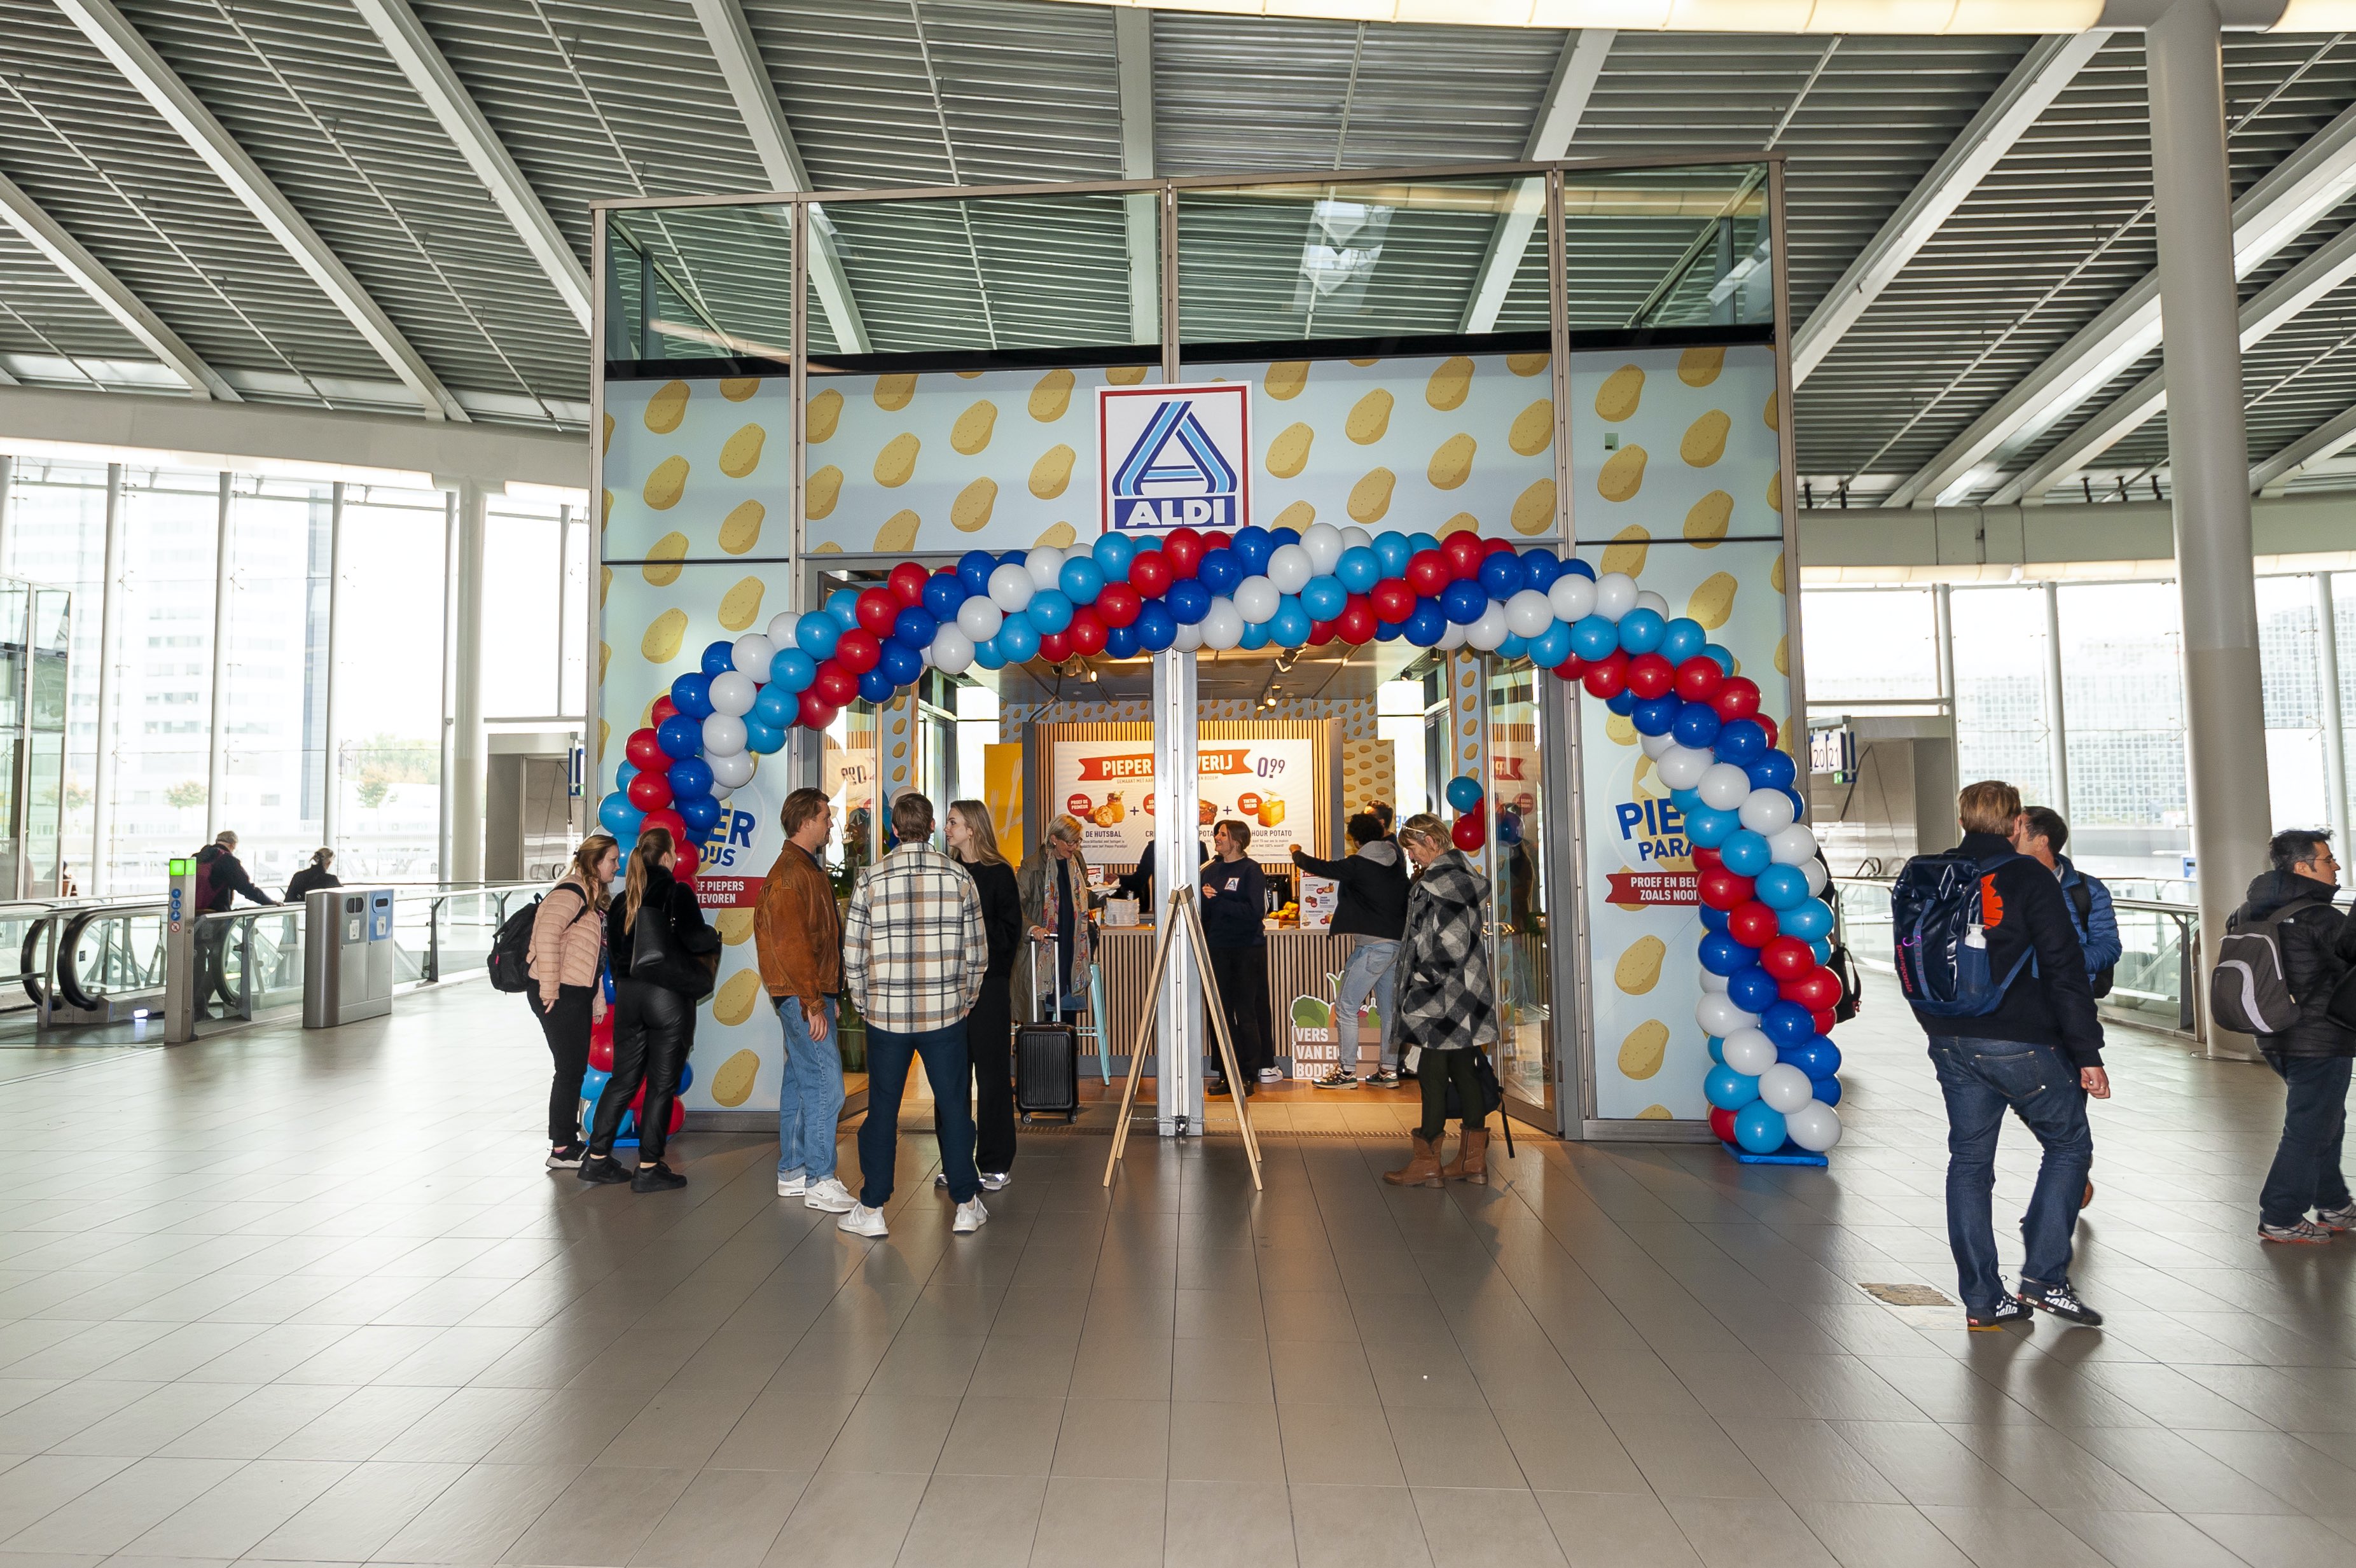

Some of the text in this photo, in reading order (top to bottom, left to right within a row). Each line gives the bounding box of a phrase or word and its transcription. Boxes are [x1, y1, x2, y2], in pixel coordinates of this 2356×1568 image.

[1126, 499, 1225, 527] ALDI
[1813, 749, 1825, 768] 20
[1829, 746, 1840, 767] 21
[1102, 758, 1153, 777] PIEPER
[1257, 757, 1285, 779] 0.99
[1616, 798, 1684, 840] PIE
[707, 880, 744, 891] PIEPERS
[1631, 877, 1697, 887] PROEF EN BEL
[696, 893, 736, 903] TEVOREN
[1640, 889, 1671, 900] ZOALS
[1295, 1027, 1329, 1042] VERS
[1296, 1045, 1322, 1060] VAN
